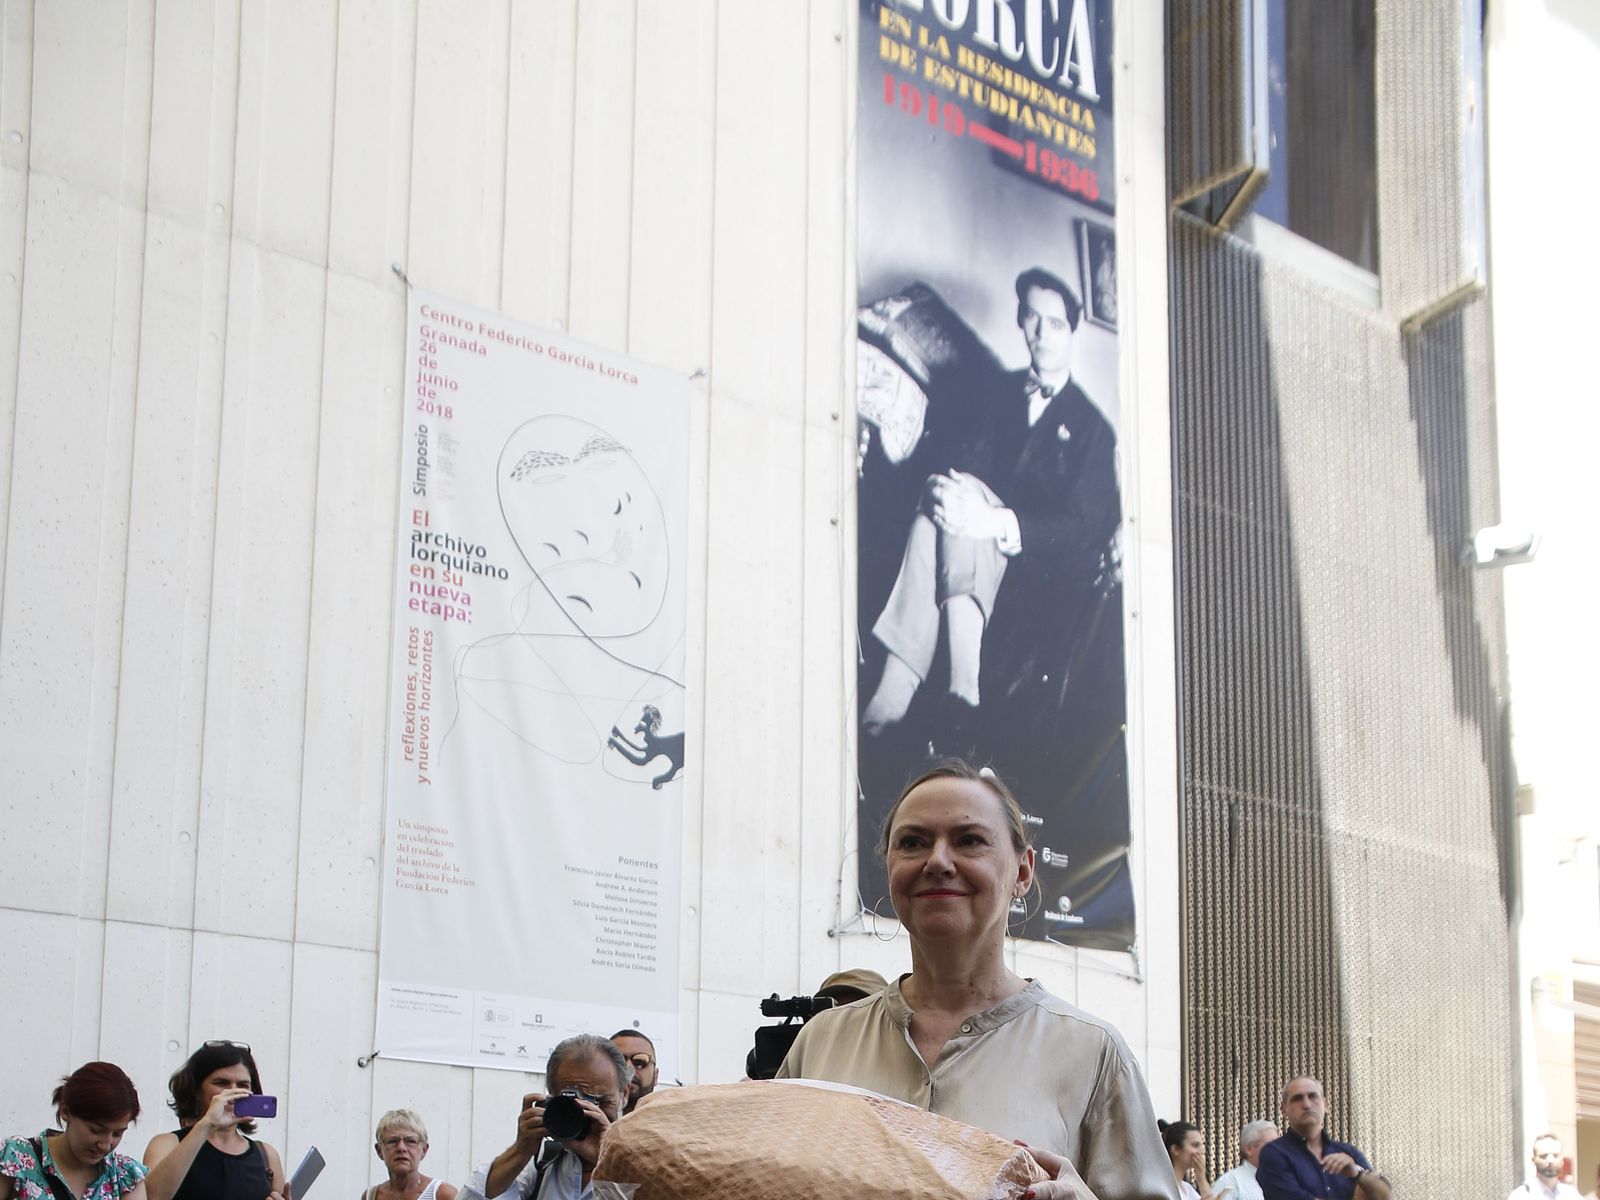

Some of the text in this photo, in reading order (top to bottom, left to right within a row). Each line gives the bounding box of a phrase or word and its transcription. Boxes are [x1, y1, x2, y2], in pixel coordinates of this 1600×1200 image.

[880, 5, 1096, 131] EN LA RESIDENCIA
[880, 34, 1096, 159] DE ESTUDIANTES
[419, 339, 437, 355] 26
[420, 325, 488, 356] Granada
[420, 304, 474, 332] Centro
[479, 323, 544, 353] Federico
[599, 361, 638, 384] Lorca
[419, 353, 438, 370] de
[417, 369, 458, 391] junio
[417, 384, 436, 400] de
[417, 399, 454, 419] 2018
[413, 424, 430, 496] Simposio
[412, 509, 429, 527] El
[412, 529, 487, 558] archivo
[411, 542, 509, 580] lorquiano
[410, 563, 463, 587] en su
[409, 580, 471, 606] nueva
[408, 598, 472, 624] etapa:
[402, 626, 419, 761] reflexiones, retos
[418, 630, 433, 785] y nuevos horizontes
[618, 856, 658, 869] Ponentes
